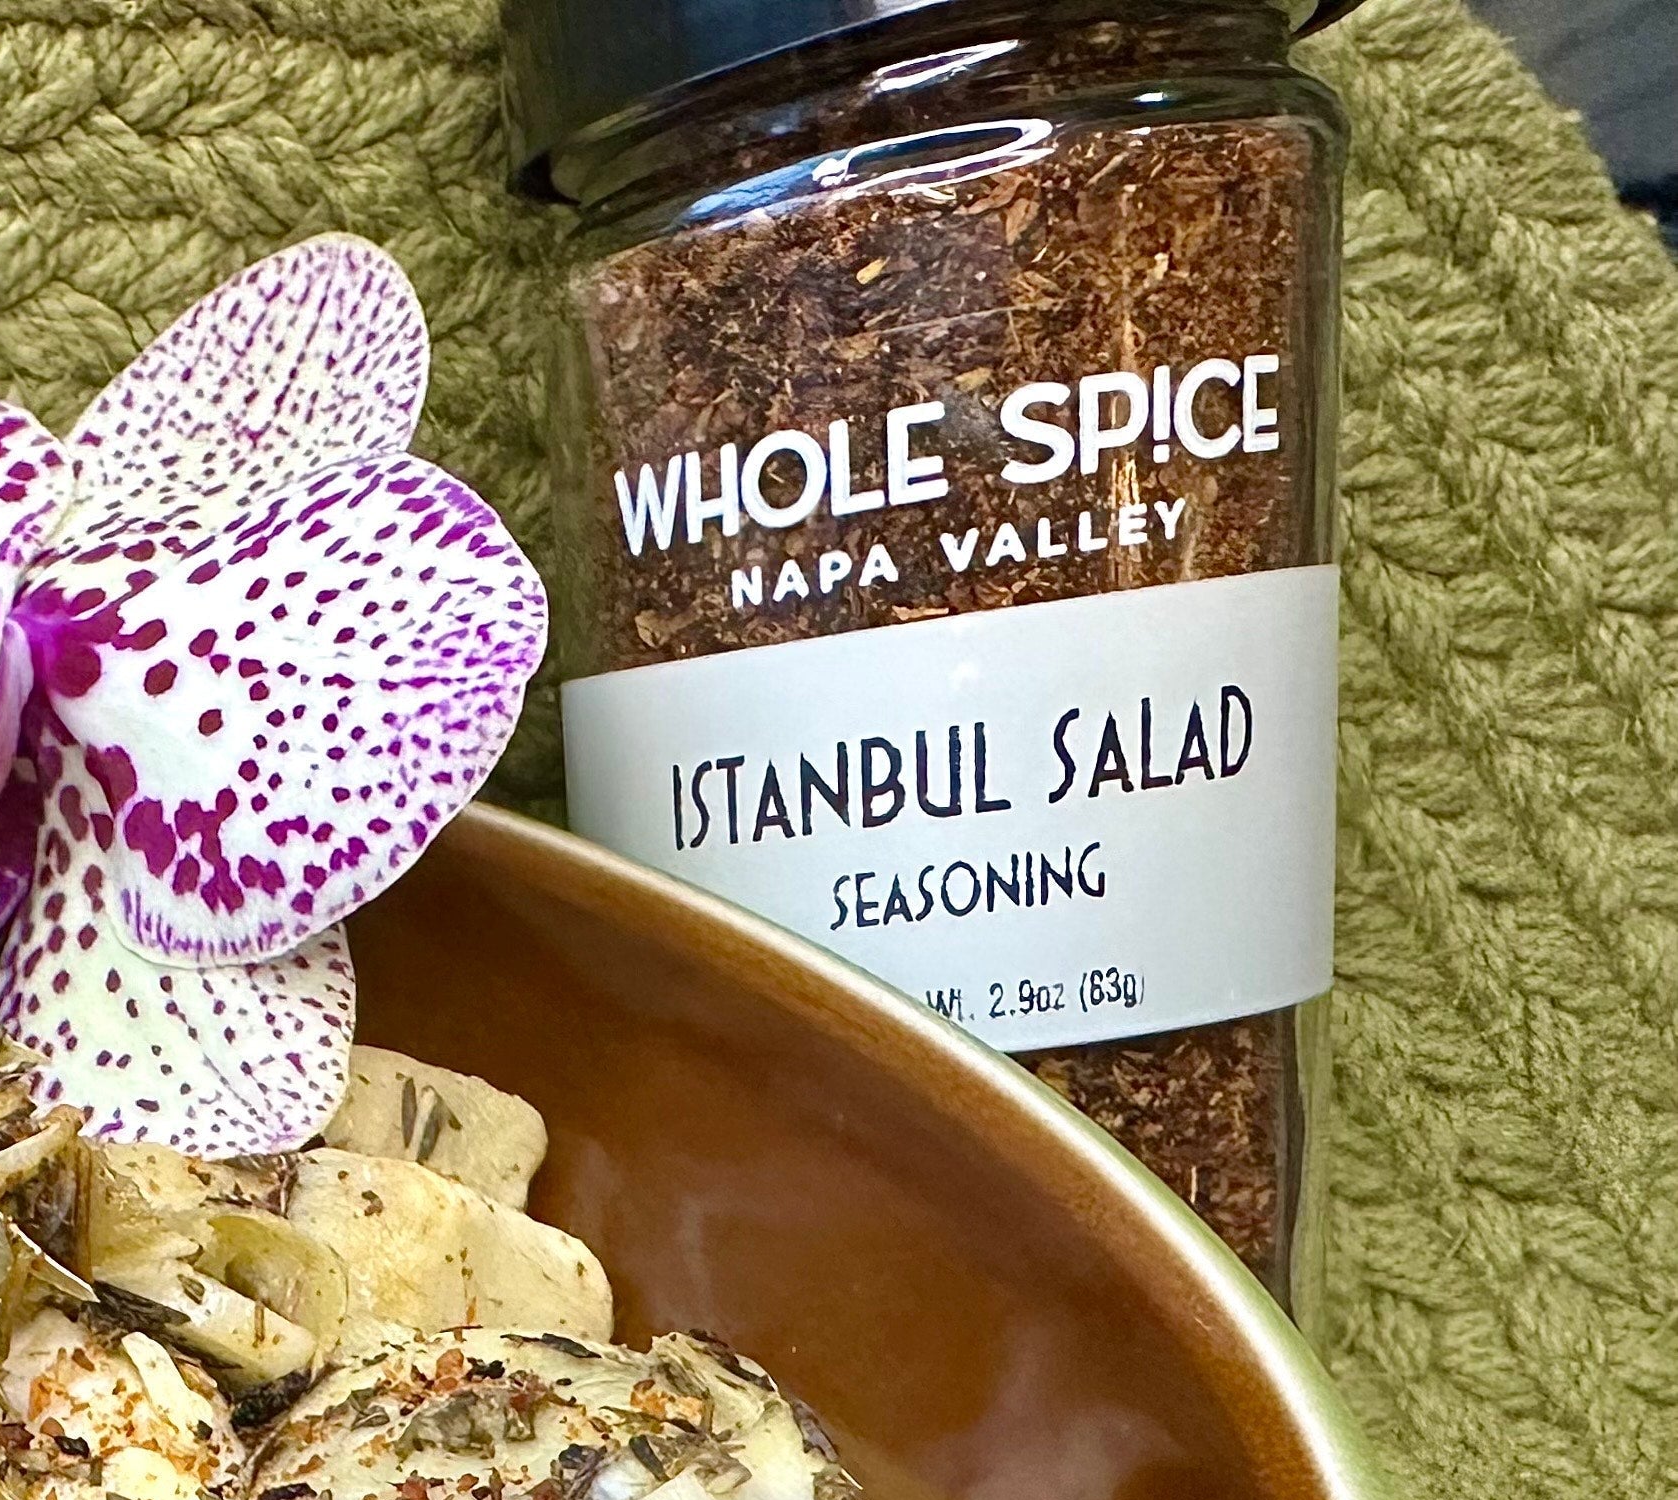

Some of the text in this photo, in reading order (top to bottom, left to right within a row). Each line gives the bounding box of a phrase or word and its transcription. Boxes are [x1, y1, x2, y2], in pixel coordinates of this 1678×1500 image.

[614, 400, 949, 557] WHOLE
[731, 497, 1186, 608] NAPA VALLEY
[672, 685, 1253, 850] ISTANBUL SALAD
[829, 841, 1105, 931] SEASONING
[988, 979, 1065, 1018] 2.9oz
